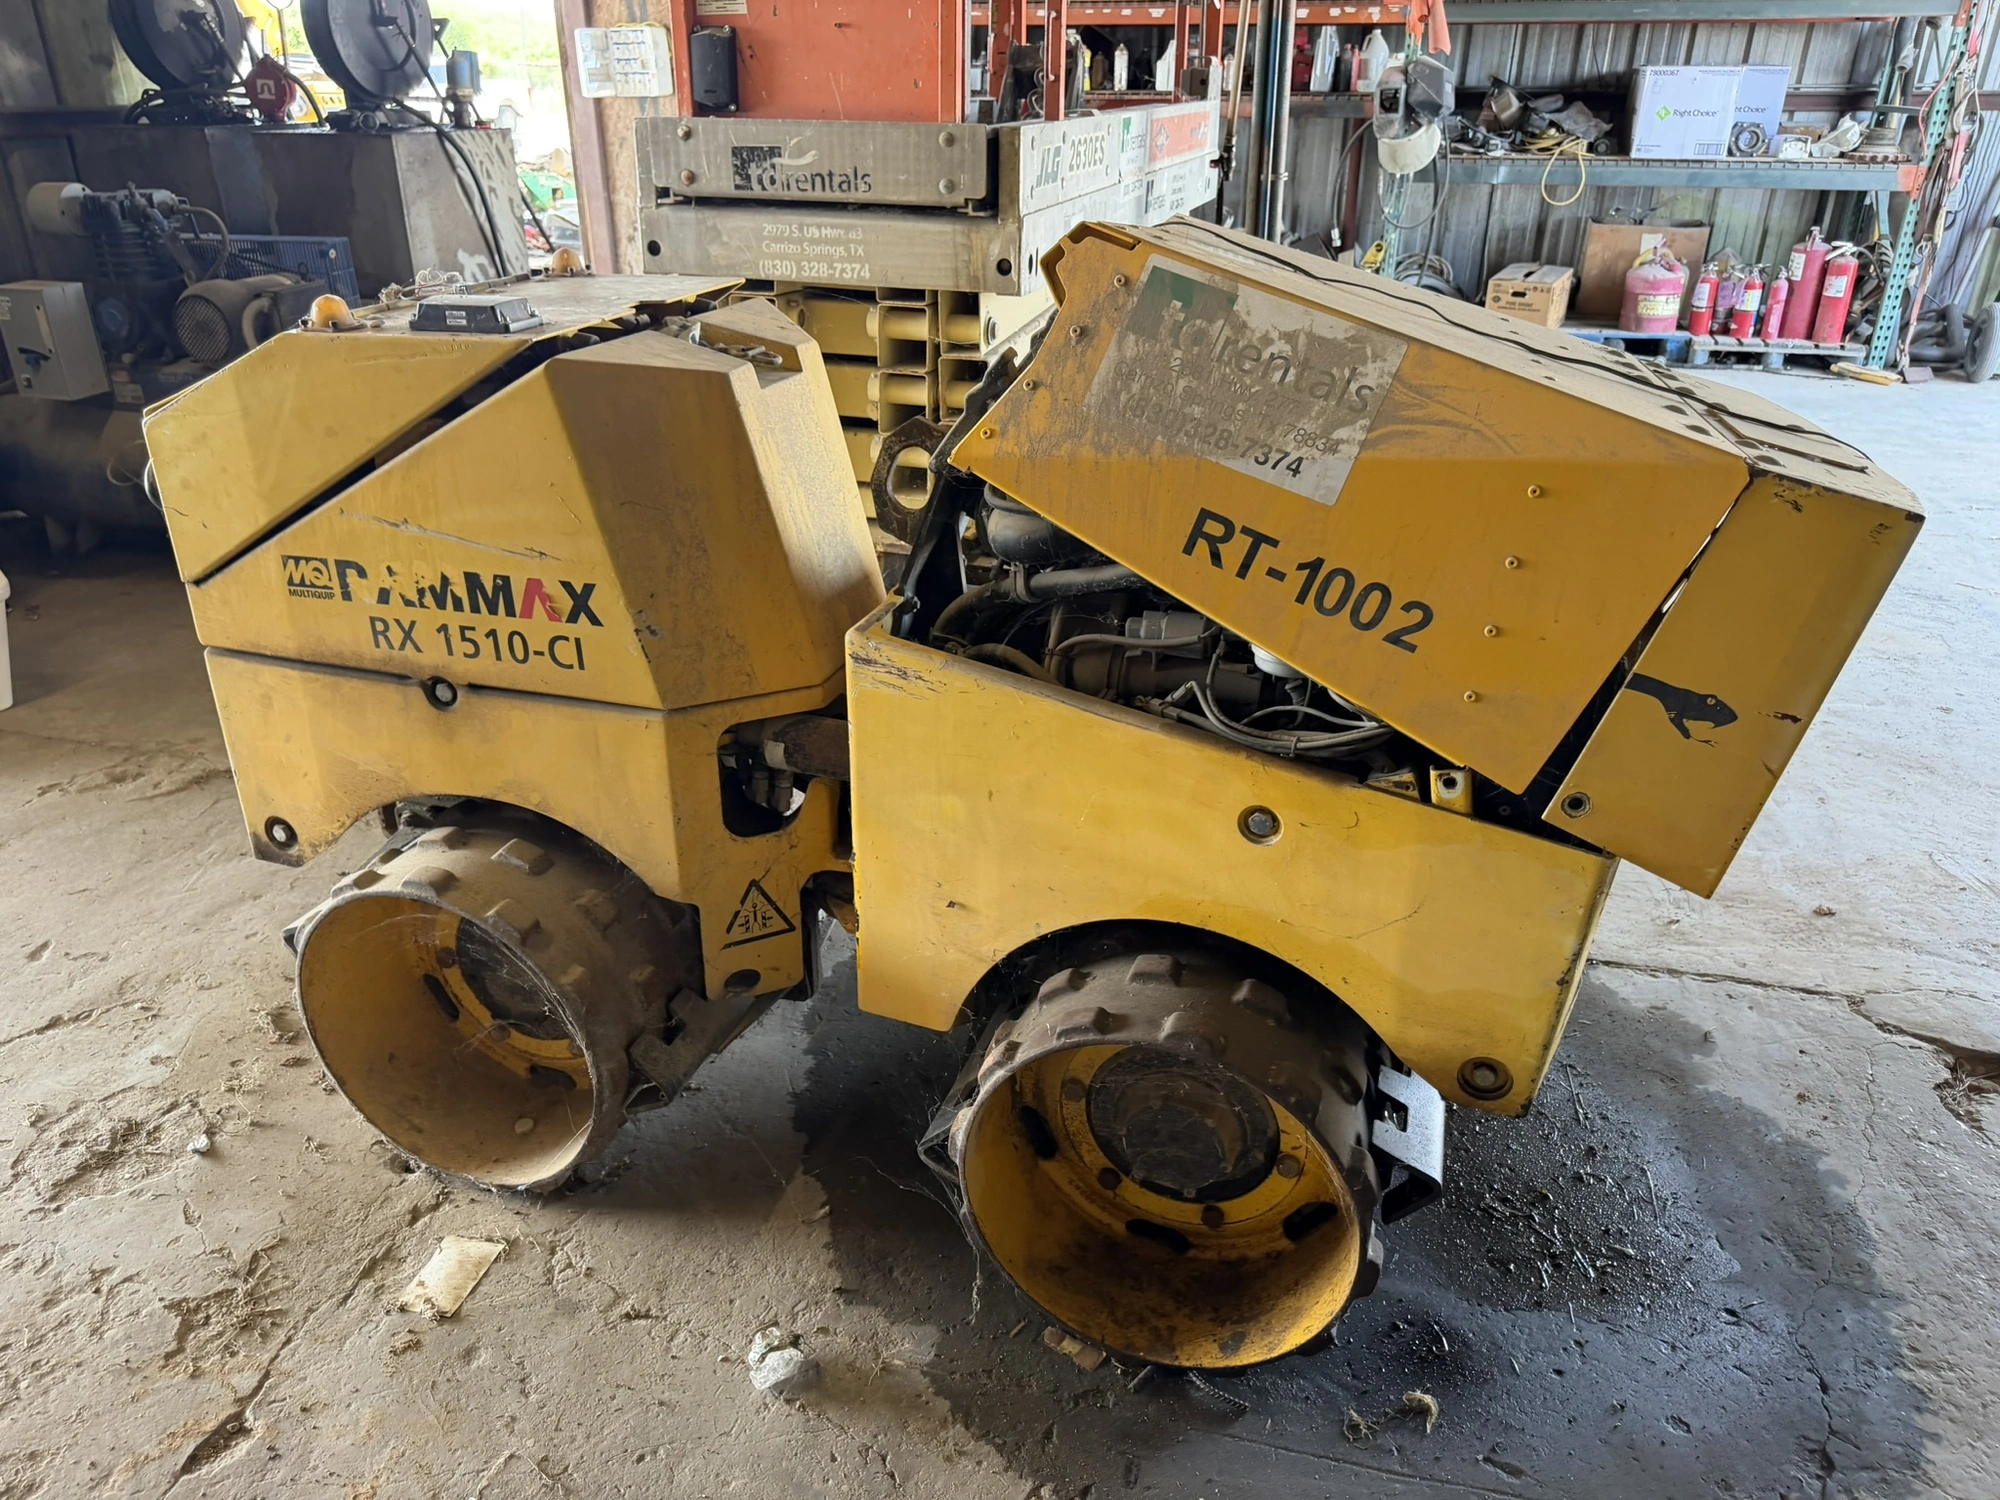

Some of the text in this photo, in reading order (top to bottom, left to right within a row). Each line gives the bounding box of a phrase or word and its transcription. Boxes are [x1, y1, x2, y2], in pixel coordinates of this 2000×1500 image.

[1649, 69, 1680, 77] 78000367
[1672, 108, 1717, 118] Right Choice
[1743, 106, 1766, 114] Choice
[1068, 134, 1106, 173] 2630ES
[762, 240, 865, 259] Carrizo Springs, TX
[759, 259, 871, 280] (830) 328-7374
[1282, 424, 1340, 455] 78834
[1181, 507, 1434, 654] RT-1002
[288, 588, 336, 601] MULTIQUIP
[368, 615, 586, 672] RX 1510-CI
